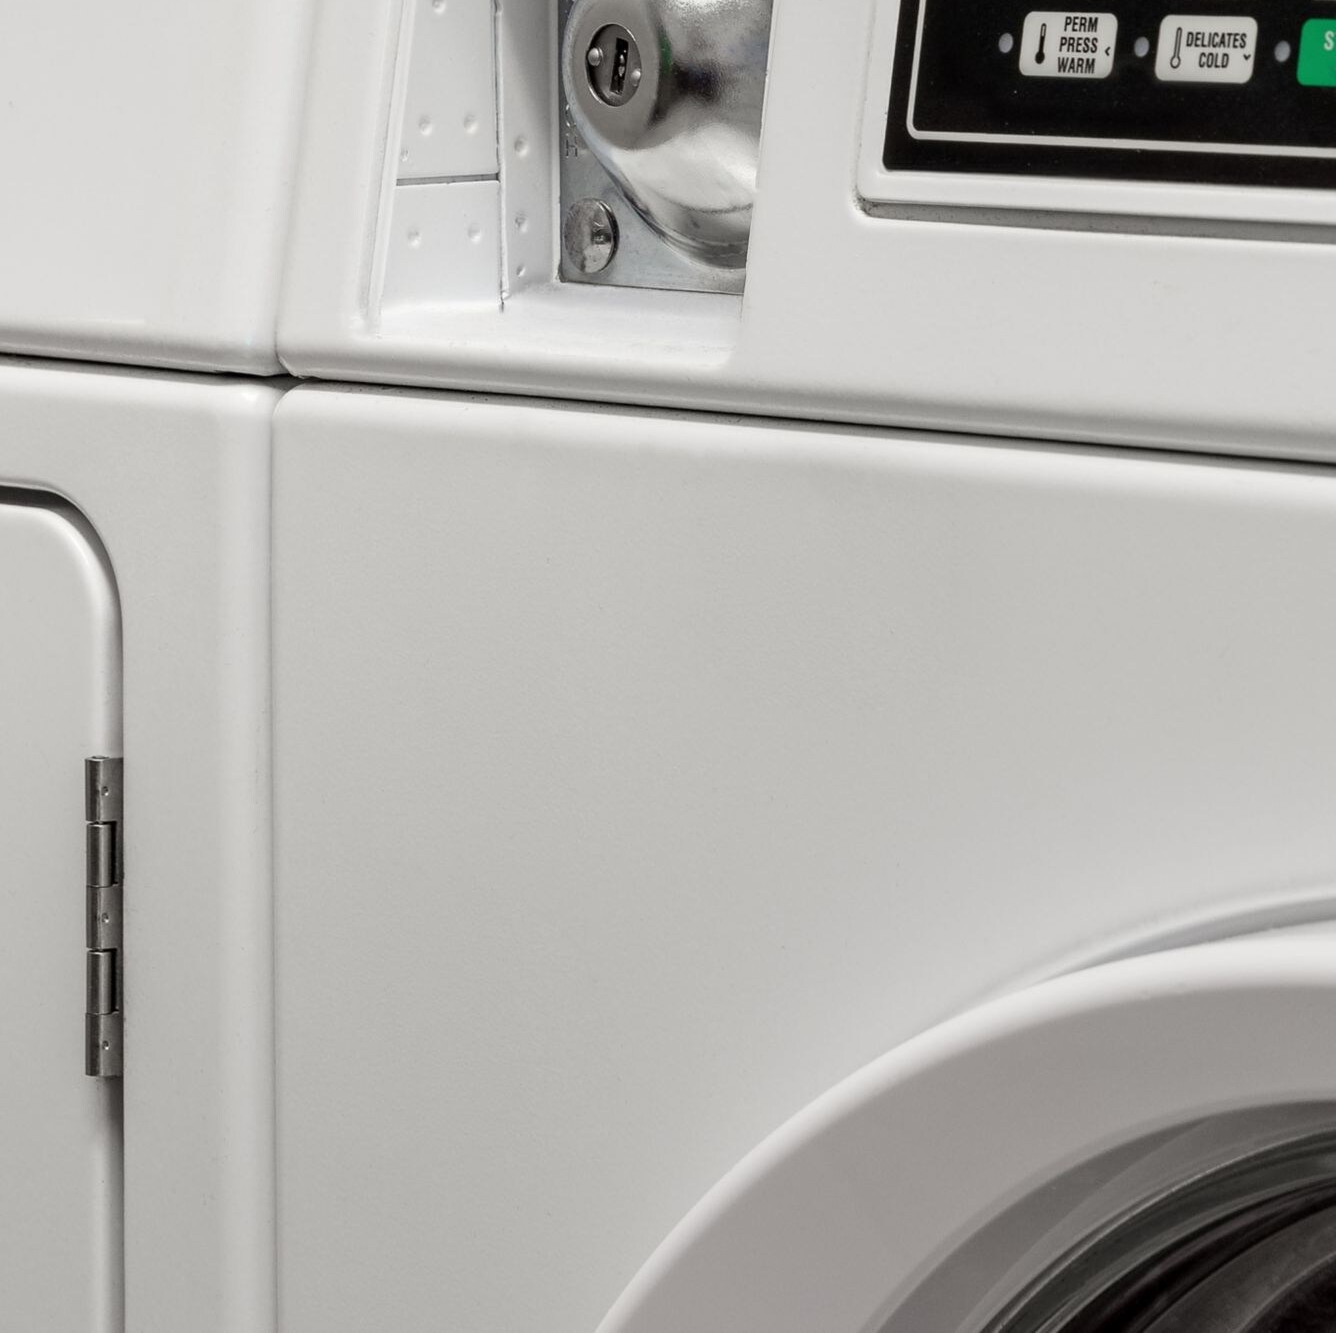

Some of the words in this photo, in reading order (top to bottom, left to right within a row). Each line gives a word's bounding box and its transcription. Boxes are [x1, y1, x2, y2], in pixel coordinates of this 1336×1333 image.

[1064, 16, 1098, 32] PERM
[1059, 37, 1098, 53] PRESS
[1186, 32, 1247, 49] DELICATES
[1058, 57, 1095, 74] WARM
[1199, 52, 1229, 68] COLD
